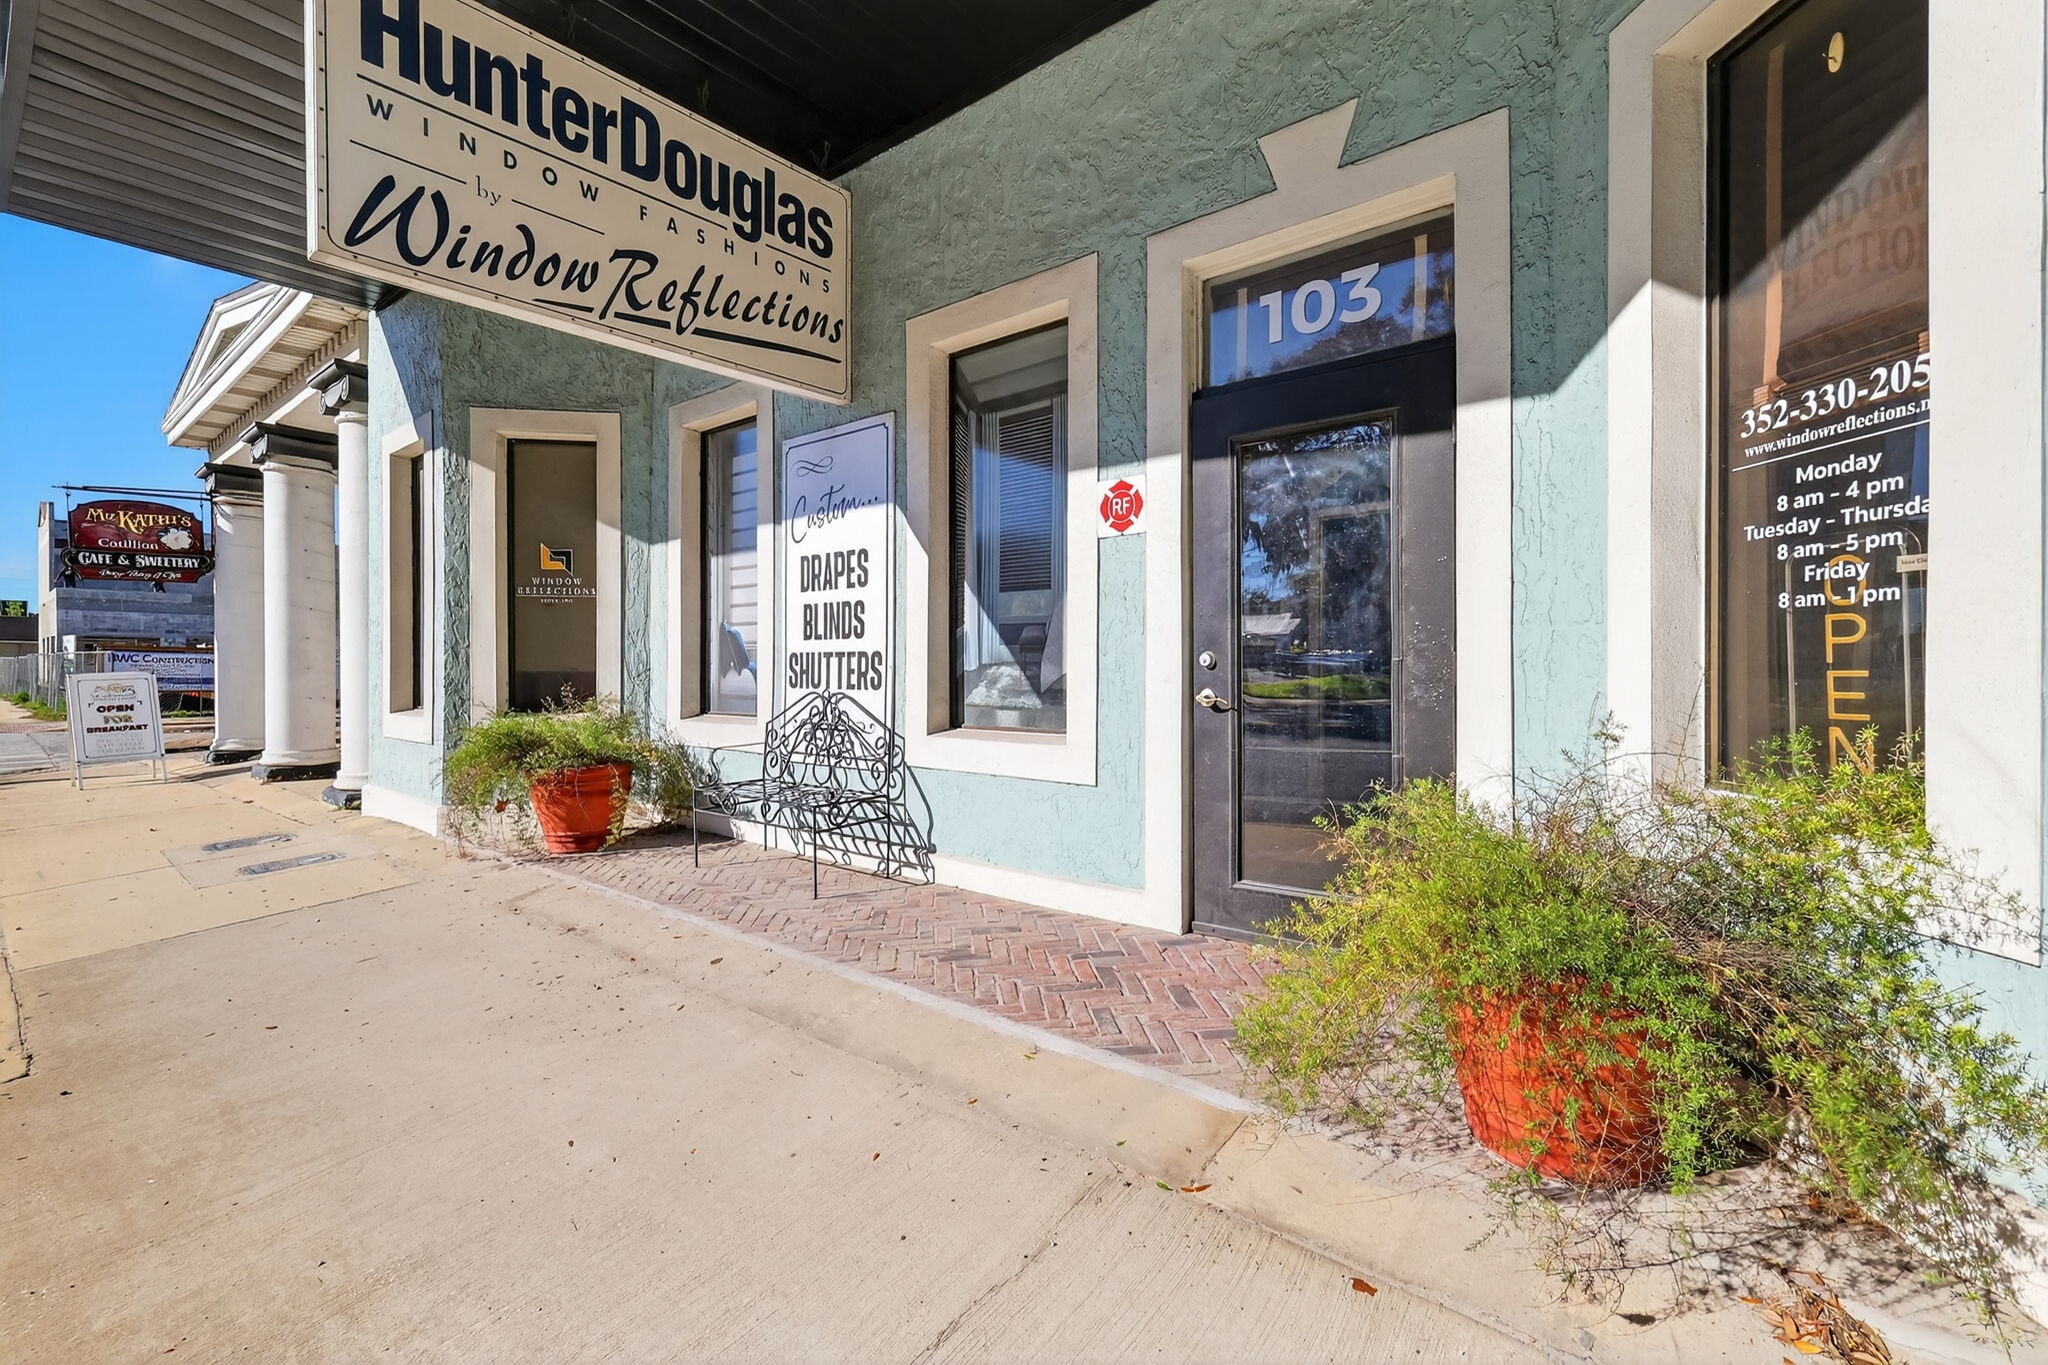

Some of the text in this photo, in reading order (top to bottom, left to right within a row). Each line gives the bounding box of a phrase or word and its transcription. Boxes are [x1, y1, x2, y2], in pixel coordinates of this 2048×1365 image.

[366, 93, 831, 294] WINDOW FASHIONS
[474, 175, 502, 206] by
[344, 174, 845, 344] Window Reflections
[1259, 262, 1382, 344] 103
[1796, 452, 1883, 484] Monday
[1112, 496, 1131, 516] RF
[1776, 495, 1789, 512] 8
[1793, 490, 1824, 510] am
[1845, 480, 1860, 498] 4
[1866, 475, 1904, 502] pm
[790, 484, 879, 544] Custom...
[1744, 516, 1822, 542] Tuesday
[118, 554, 130, 565] &
[1776, 543, 1789, 561] 8
[1793, 540, 1825, 558] am
[1845, 533, 1859, 551] 5
[1865, 530, 1904, 554] pm
[531, 577, 583, 586] WINDOW
[800, 548, 869, 593] DRAPES
[1804, 560, 1870, 583] Friday
[1778, 592, 1790, 609] 8
[1794, 589, 1826, 608] am
[1847, 586, 1856, 605] 1
[1863, 584, 1901, 607] pm
[803, 600, 865, 641] BLINDS
[788, 651, 883, 691] SHUTTERS
[96, 704, 135, 714] OPEN
